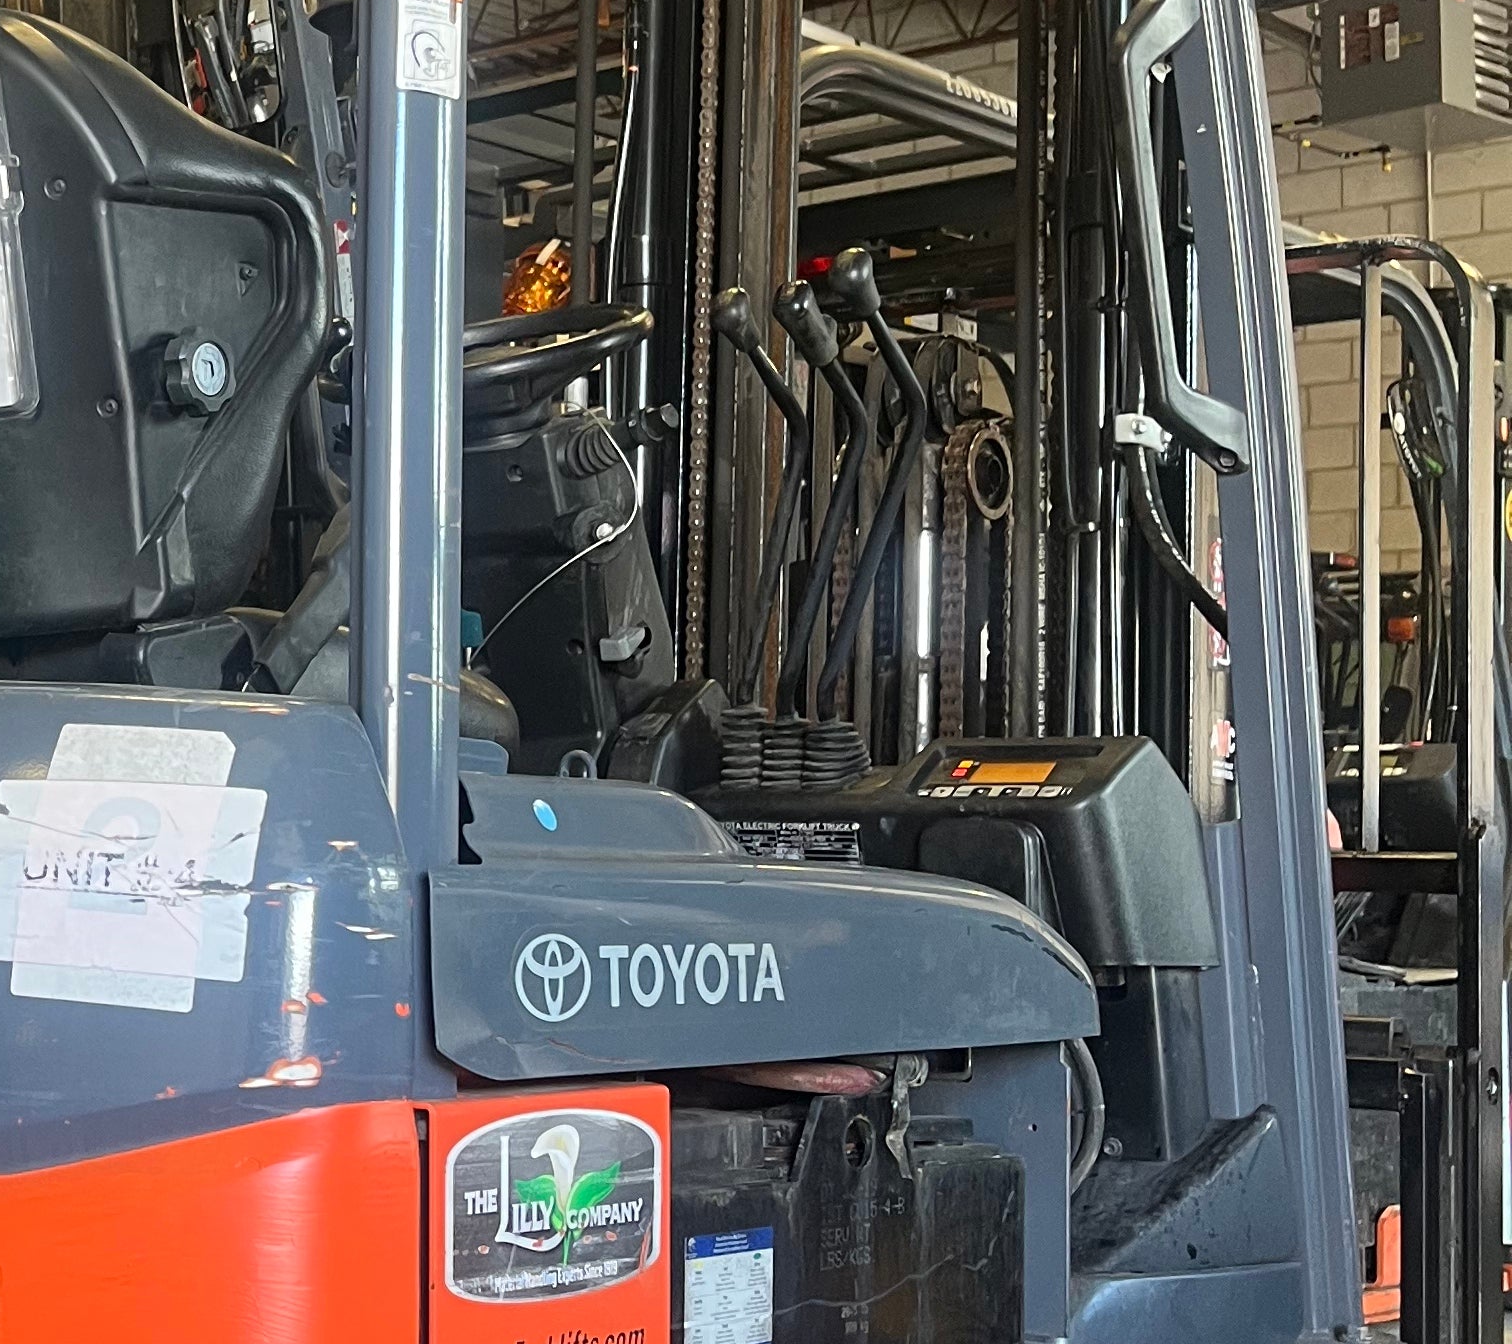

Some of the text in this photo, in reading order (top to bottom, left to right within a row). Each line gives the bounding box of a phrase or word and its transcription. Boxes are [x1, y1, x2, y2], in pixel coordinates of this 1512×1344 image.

[742, 822, 781, 830] ELECTRIC
[599, 942, 785, 1007] TOYOTA
[464, 1135, 643, 1252] THE LILLY COMPANY
[557, 1265, 584, 1286] Experts
[584, 1262, 603, 1280] Since
